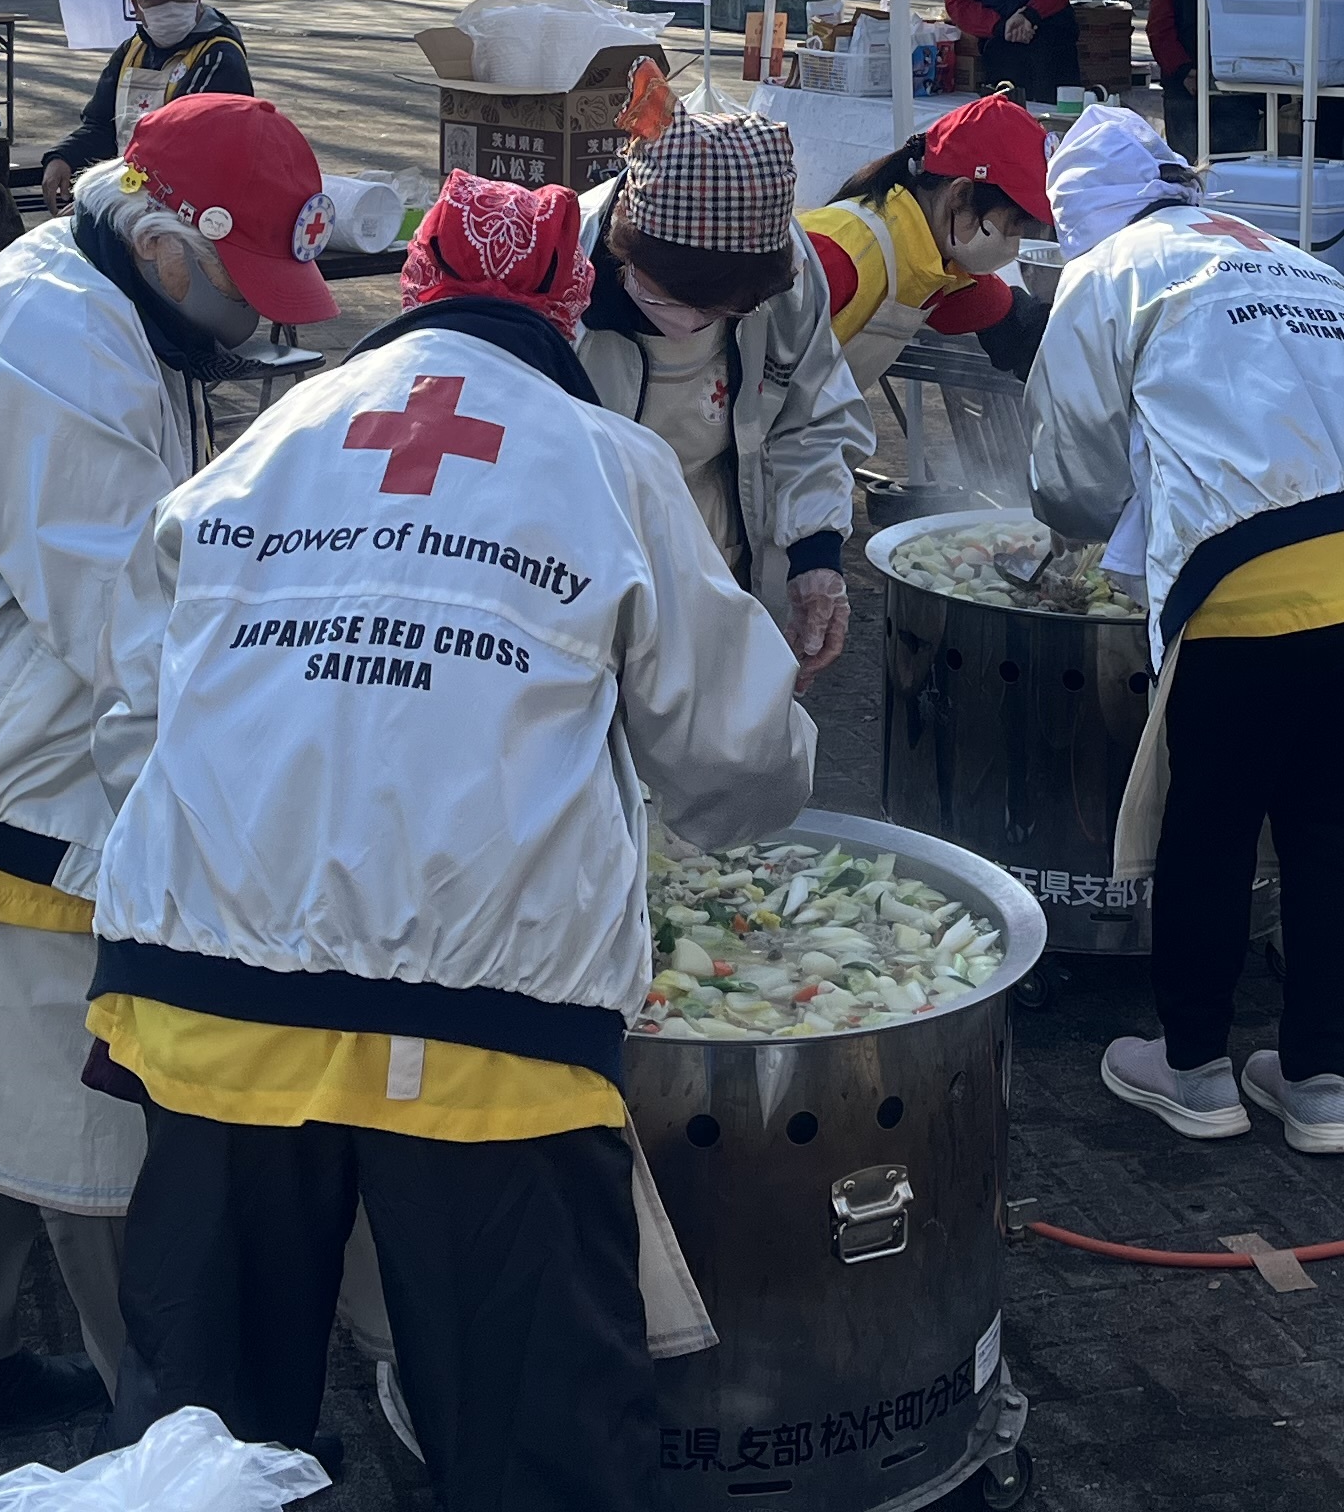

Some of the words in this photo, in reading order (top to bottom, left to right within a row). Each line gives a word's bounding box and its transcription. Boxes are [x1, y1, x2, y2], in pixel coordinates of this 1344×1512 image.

[491, 132, 545, 154] 茨城県産
[490, 154, 546, 184] 小松菜
[1268, 262, 1288, 277] of
[1304, 307, 1338, 323] RED
[196, 517, 255, 549] the
[256, 525, 367, 563] power
[372, 522, 414, 552] of
[417, 524, 592, 605] humanity
[229, 615, 364, 650] JAPANESE
[368, 616, 426, 650] RED
[433, 626, 531, 674] CROSS
[304, 652, 433, 692] SAITAMA
